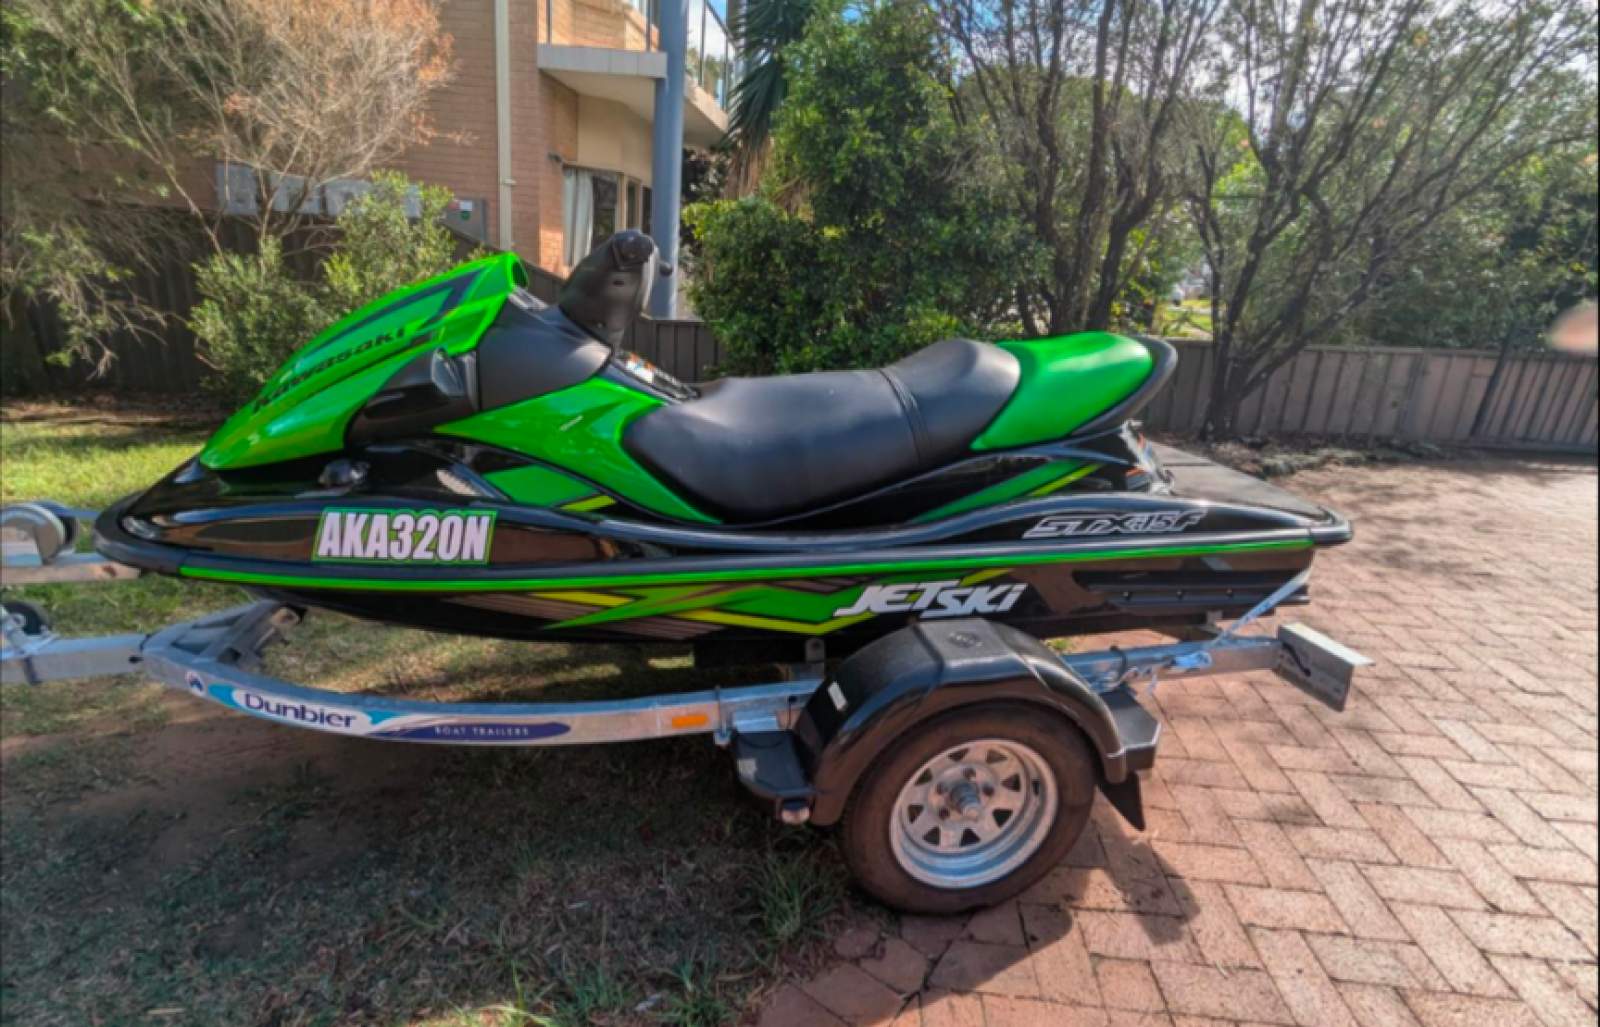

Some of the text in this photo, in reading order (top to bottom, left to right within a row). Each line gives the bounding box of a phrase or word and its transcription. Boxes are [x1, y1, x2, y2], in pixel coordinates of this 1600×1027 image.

[317, 511, 491, 561] AKA320N
[245, 693, 357, 728] Dunbier
[434, 726, 529, 737] BOAT TRAILERS
